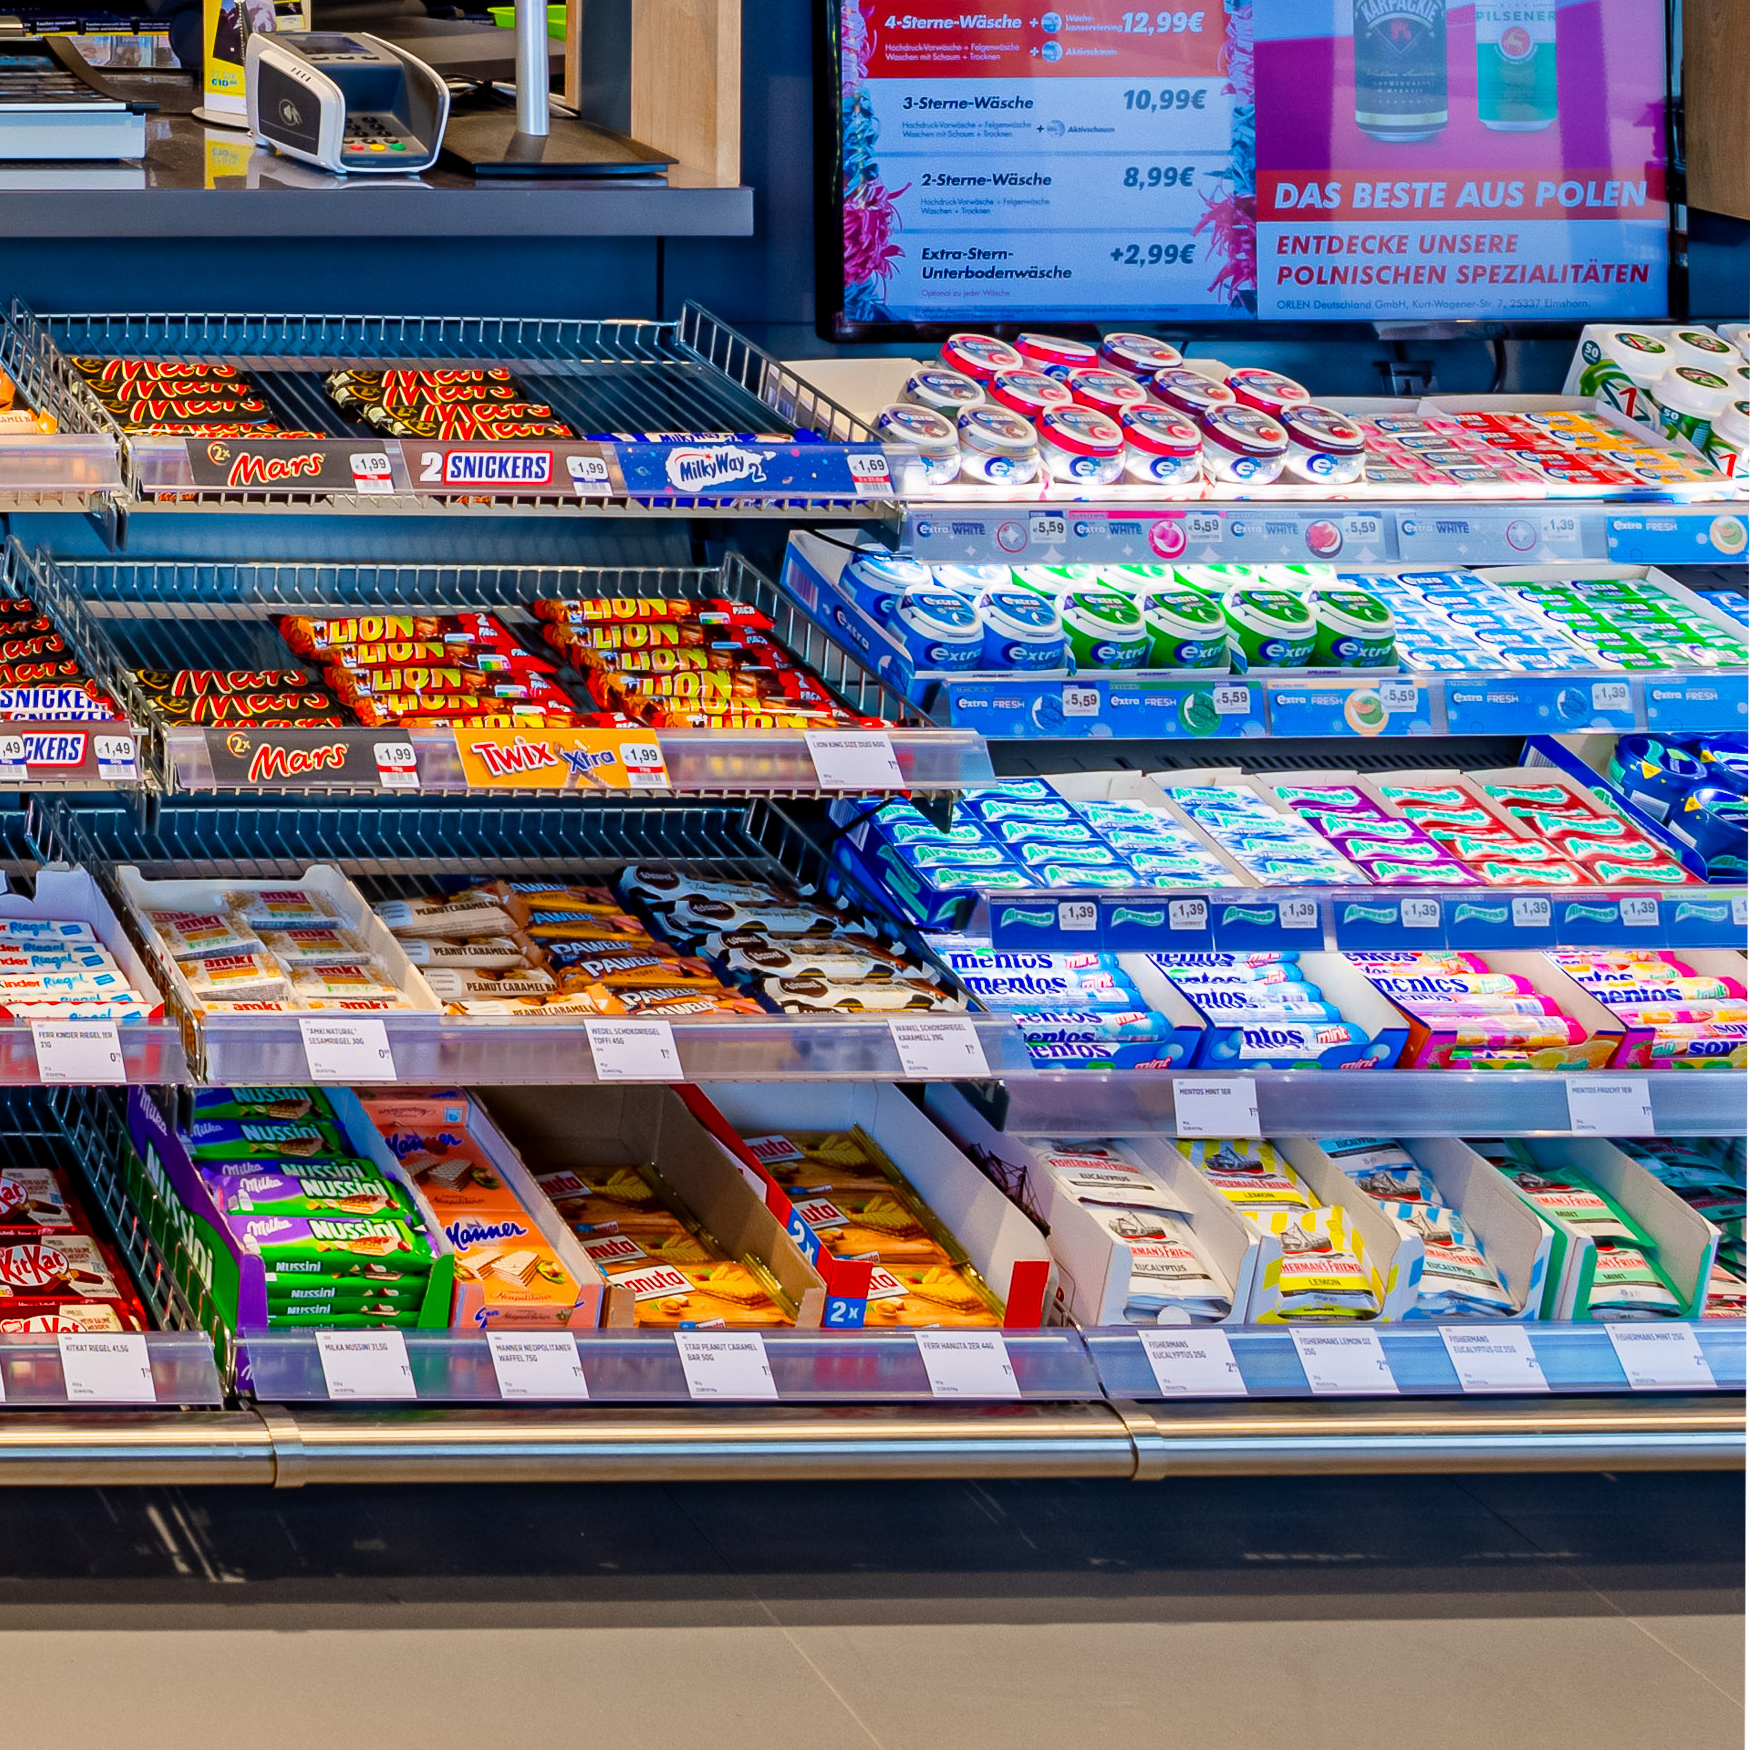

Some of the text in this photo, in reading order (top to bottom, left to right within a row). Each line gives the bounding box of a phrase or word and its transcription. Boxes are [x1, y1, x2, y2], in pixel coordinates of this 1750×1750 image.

[885, 14, 1022, 29] 4-Sterne-Wäsche
[1122, 11, 1205, 36] 12,99€
[902, 95, 1034, 110] 3-Sterne-Wäsche
[1124, 89, 1207, 113] 10,99€
[921, 172, 1052, 187] 2-Sterne-Wäsche
[1123, 166, 1195, 191] 8,99€
[1274, 180, 1647, 210] DAS BESTE AUS POLEN
[921, 248, 1014, 261] Extra-Stern-
[1277, 234, 1518, 255] ENTDECKE UNSERE
[1110, 244, 1195, 268] +2,99€
[921, 265, 1072, 280] Unterbodenwäsche
[1277, 258, 1649, 286] POLNISCHEN SPEZIALITÄTEN
[1277, 300, 1311, 309] ORLEN
[1314, 298, 1371, 309] Deutschland
[227, 452, 323, 487] Mars
[419, 452, 546, 482] 2 SNICKERS
[328, 616, 415, 643] LION
[992, 700, 1025, 710] FRESH
[247, 743, 347, 783] Mars
[472, 736, 616, 776] Twix Xtra
[203, 954, 254, 968] amki
[44, 974, 88, 989] Riegel
[961, 975, 1066, 996] mentos
[246, 1218, 292, 1237] Milka
[445, 1224, 528, 1250] Manner
[1134, 1263, 1187, 1273] EUCALYPTUS
[1309, 1278, 1341, 1287] LEMON
